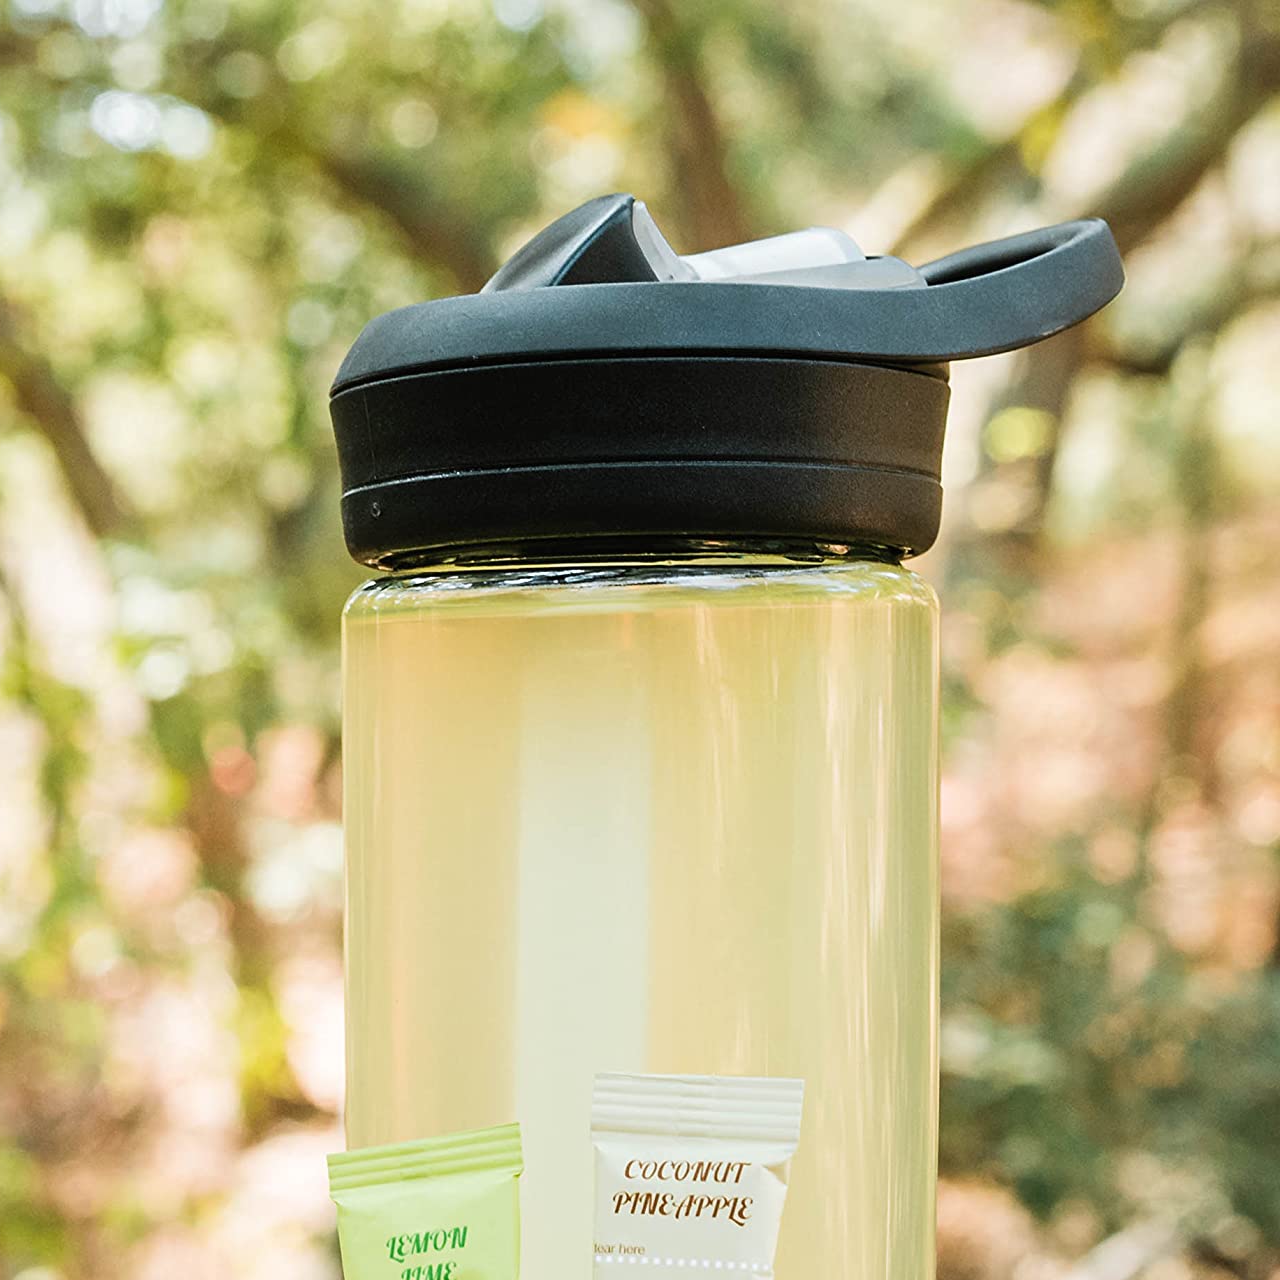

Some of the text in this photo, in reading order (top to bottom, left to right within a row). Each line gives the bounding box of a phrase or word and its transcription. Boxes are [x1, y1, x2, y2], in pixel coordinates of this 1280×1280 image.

[623, 1159, 752, 1184] COCONUT
[612, 1190, 754, 1227] PINEAPPLE
[386, 1226, 468, 1263] LEMON
[618, 1243, 646, 1255] here
